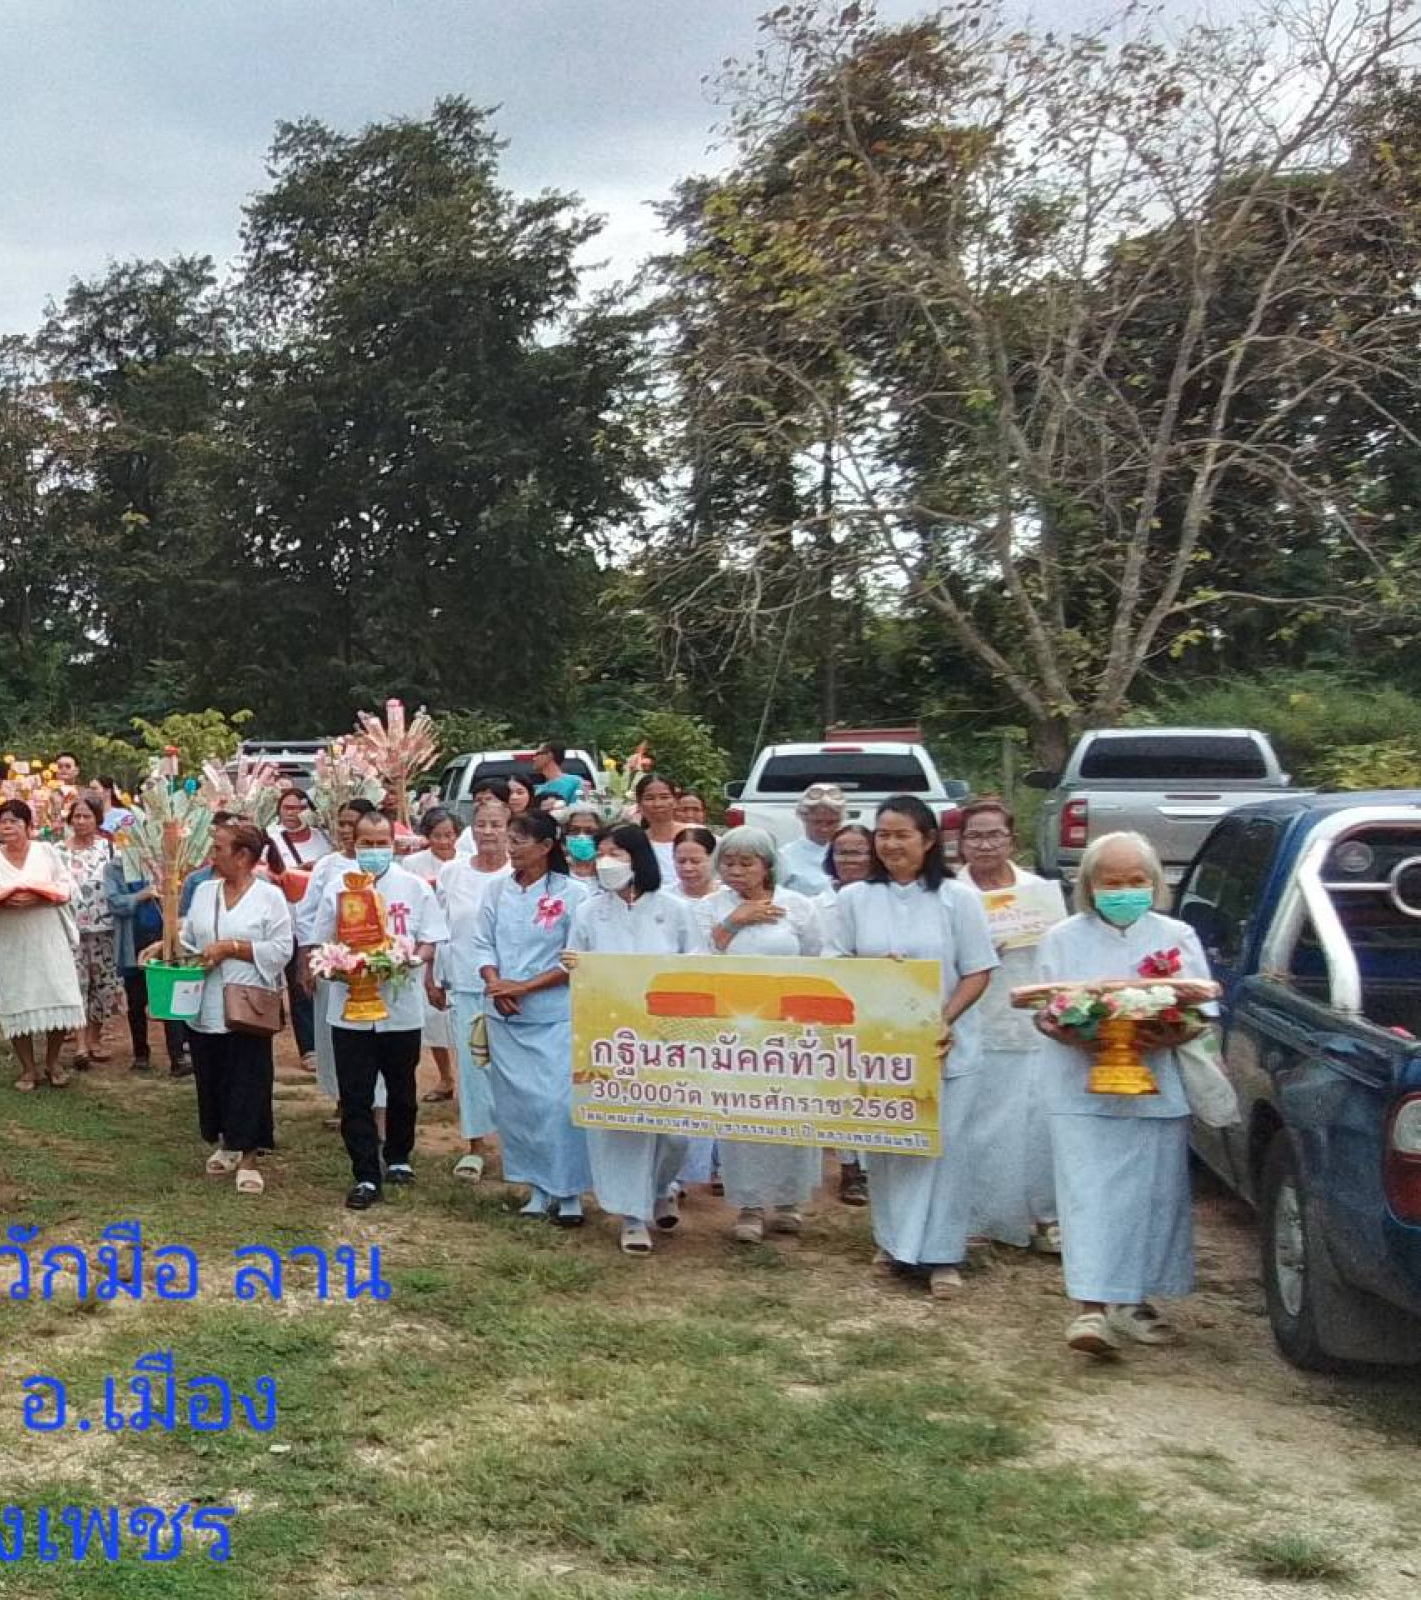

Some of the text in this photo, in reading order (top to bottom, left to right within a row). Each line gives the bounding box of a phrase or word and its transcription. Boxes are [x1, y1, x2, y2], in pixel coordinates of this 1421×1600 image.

[593, 1029, 913, 1082] กฐินสามัคคีทั่วไทย
[852, 1097, 915, 1121] 2568
